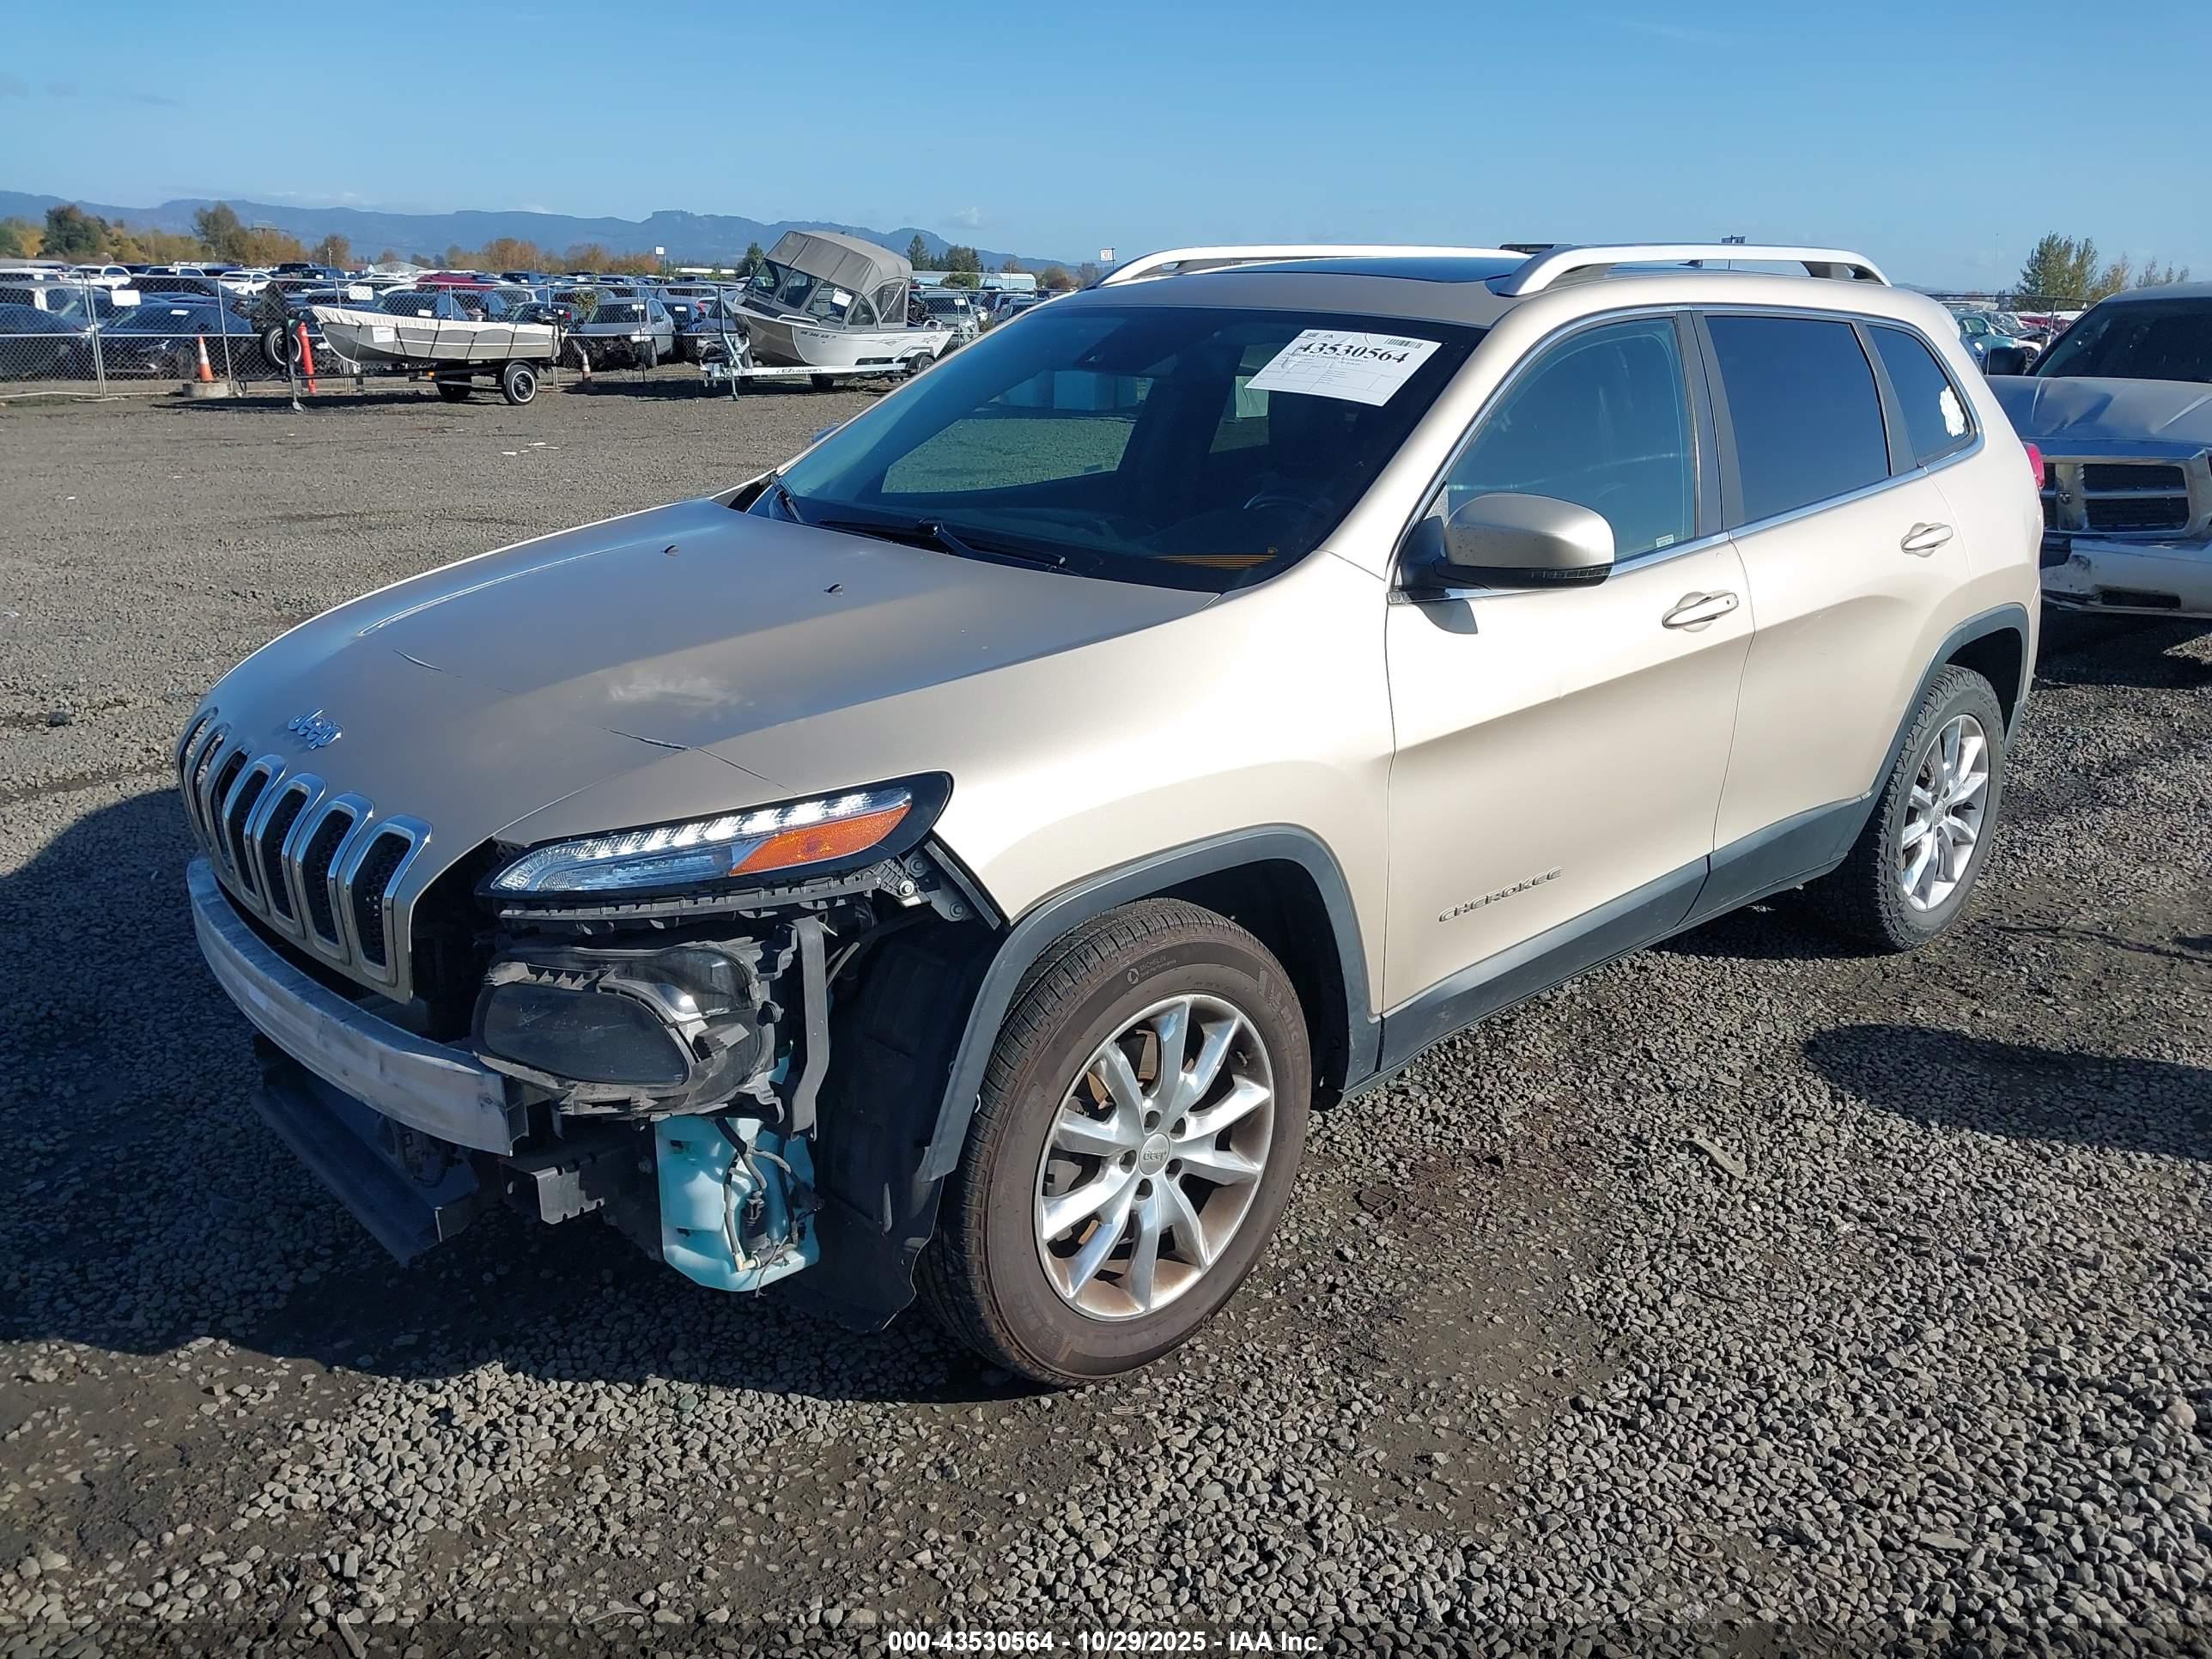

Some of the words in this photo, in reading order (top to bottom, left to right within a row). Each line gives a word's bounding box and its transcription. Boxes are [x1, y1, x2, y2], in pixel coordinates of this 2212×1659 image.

[1297, 342, 1410, 363] 43530564
[289, 708, 344, 750] Jeep
[1437, 866, 1564, 923] CHEROKEE
